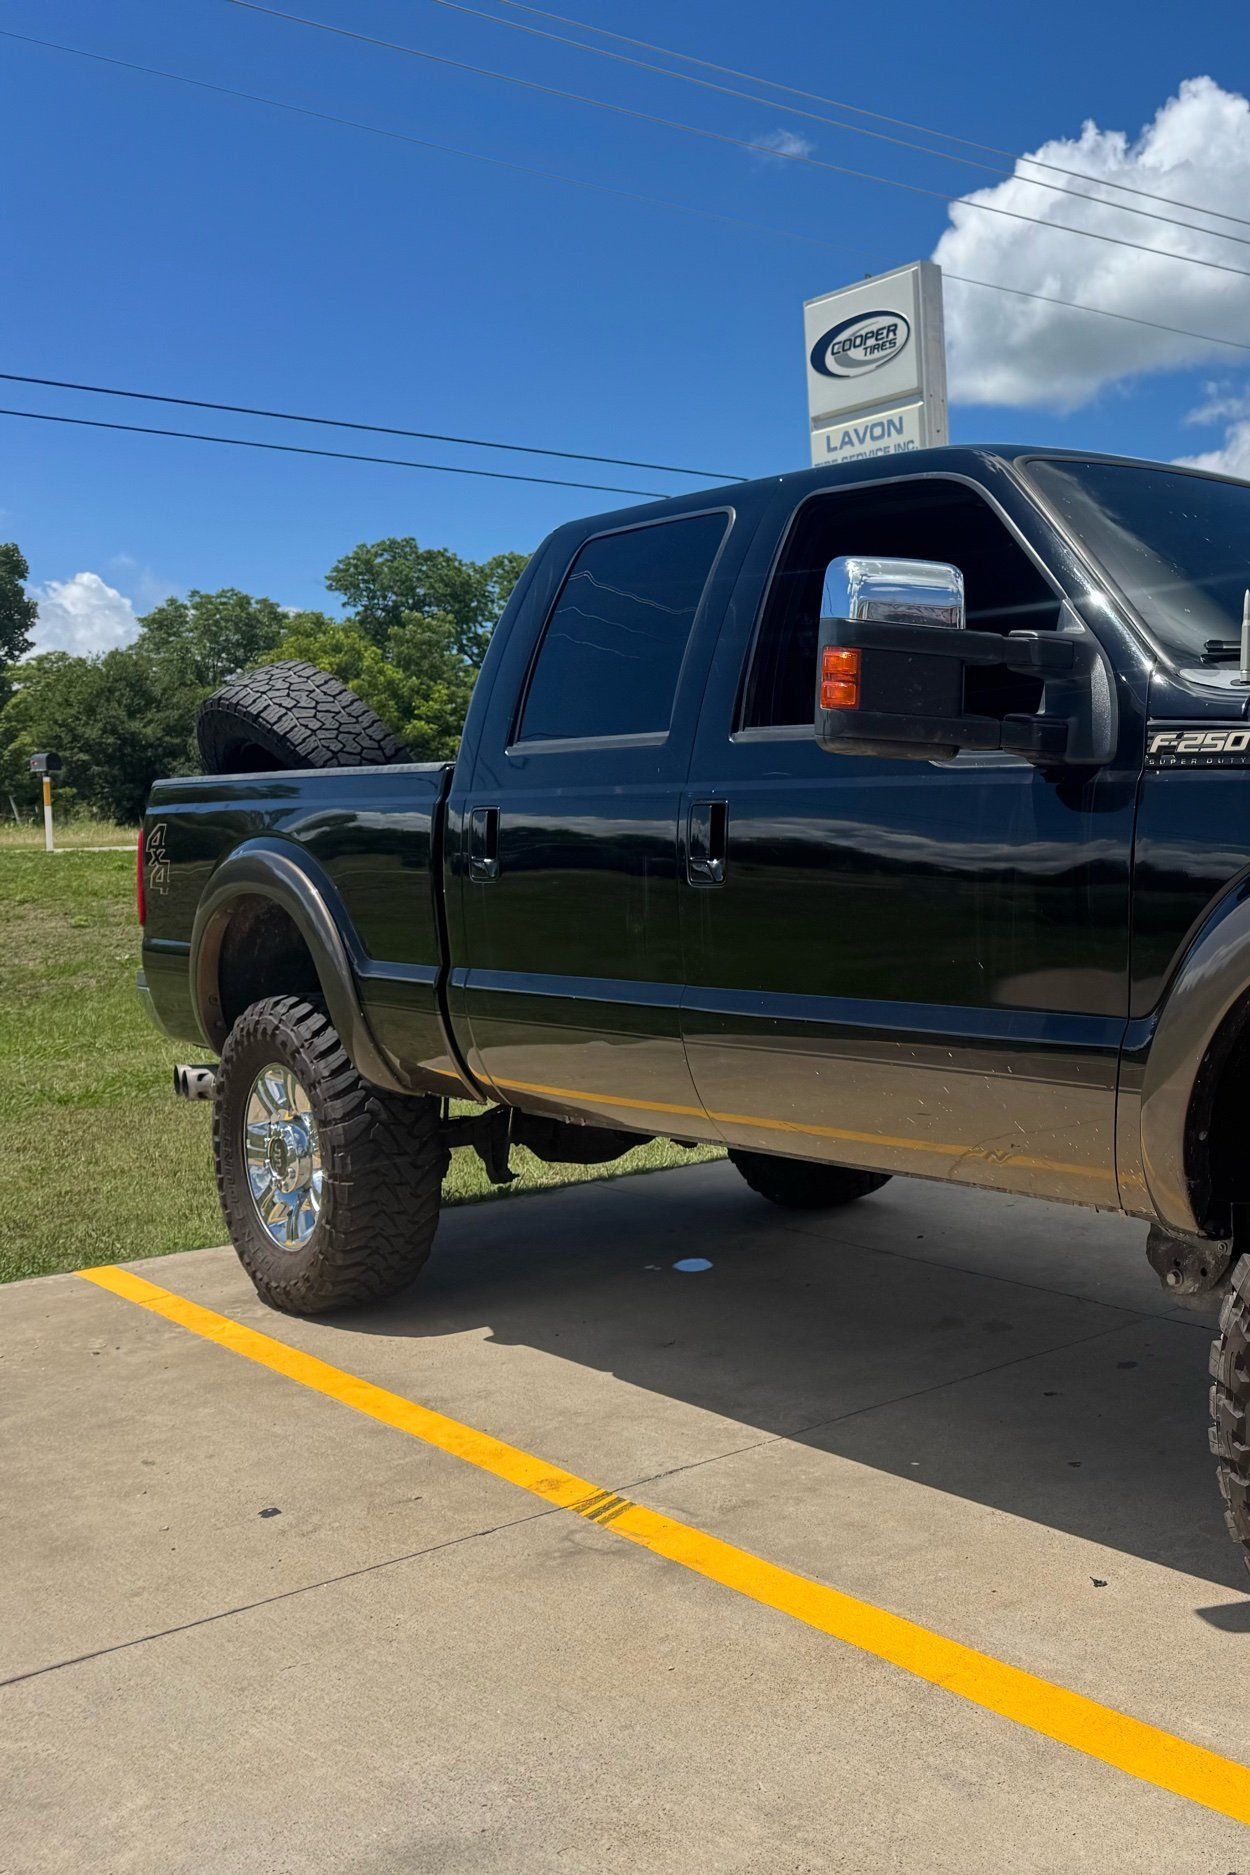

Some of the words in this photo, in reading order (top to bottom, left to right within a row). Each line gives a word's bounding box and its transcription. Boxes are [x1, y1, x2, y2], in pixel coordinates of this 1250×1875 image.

[831, 322, 898, 356] COOPER
[862, 337, 898, 357] TIRES
[826, 416, 904, 453] LAVON
[1149, 757, 1198, 765] SUPER
[1206, 756, 1247, 764] DUTY
